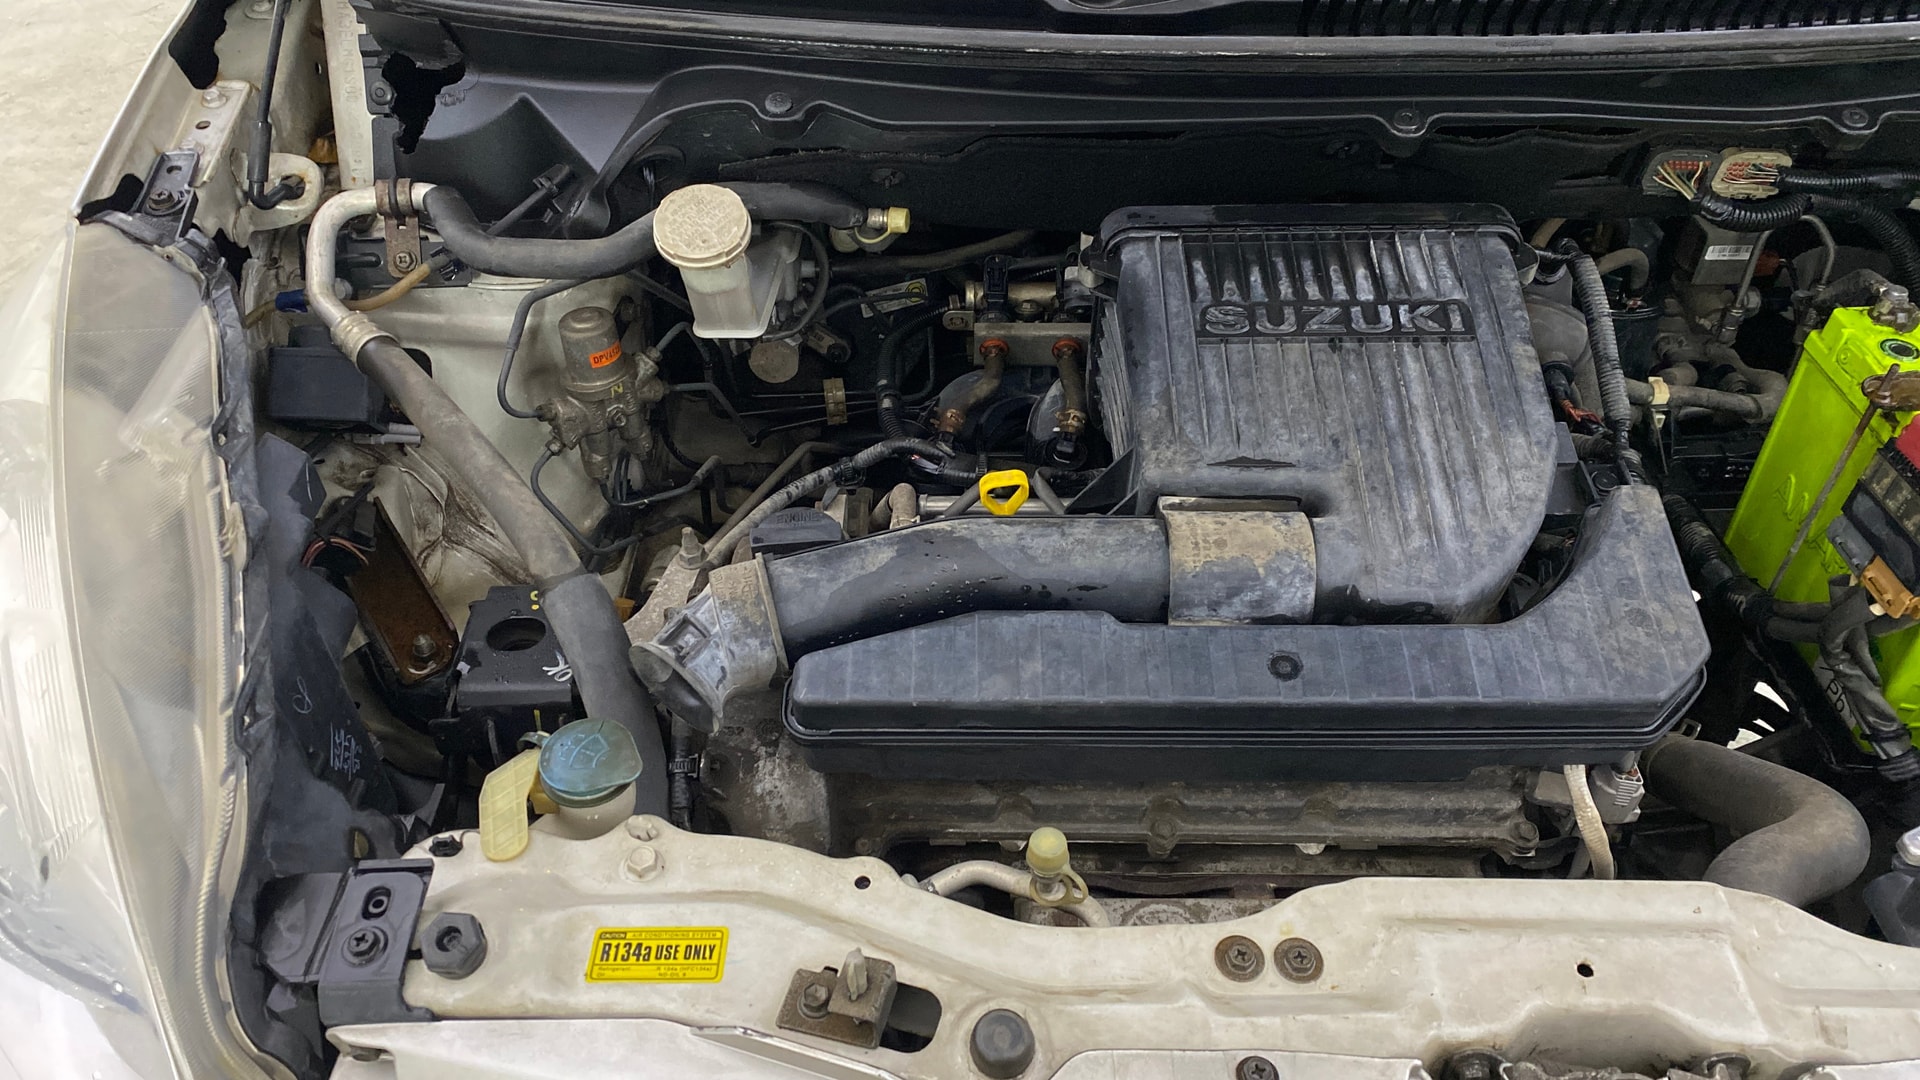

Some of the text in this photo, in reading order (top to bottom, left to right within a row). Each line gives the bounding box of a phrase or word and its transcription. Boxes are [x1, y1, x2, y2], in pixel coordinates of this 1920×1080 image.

[1205, 304, 1465, 334] SUZUKI
[600, 942, 717, 962] R134a USE ONLY
